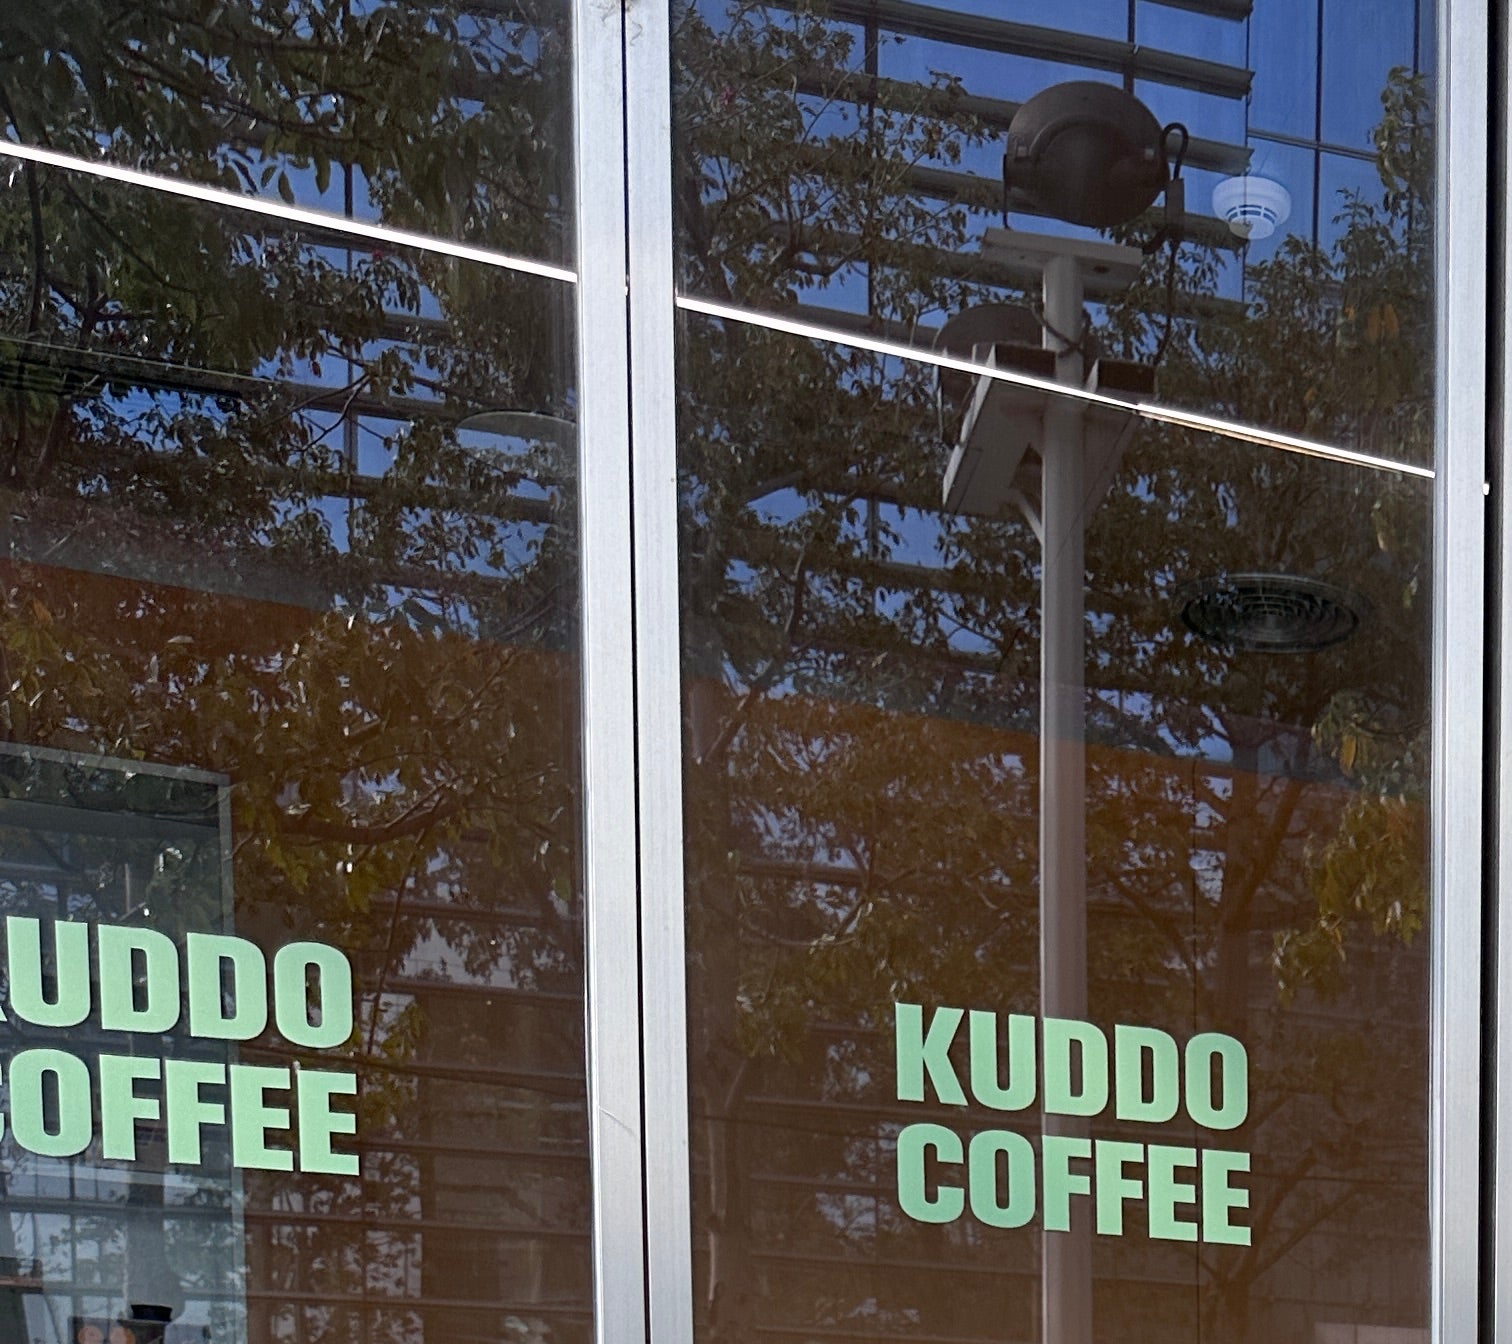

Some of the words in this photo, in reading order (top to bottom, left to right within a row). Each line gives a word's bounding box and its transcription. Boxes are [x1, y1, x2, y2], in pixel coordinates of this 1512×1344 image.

[0, 916, 353, 1047] UDDO
[0, 1048, 359, 1175] OFFEE
[895, 1003, 1249, 1129] KUDDO
[897, 1123, 1251, 1246] COFFEE
